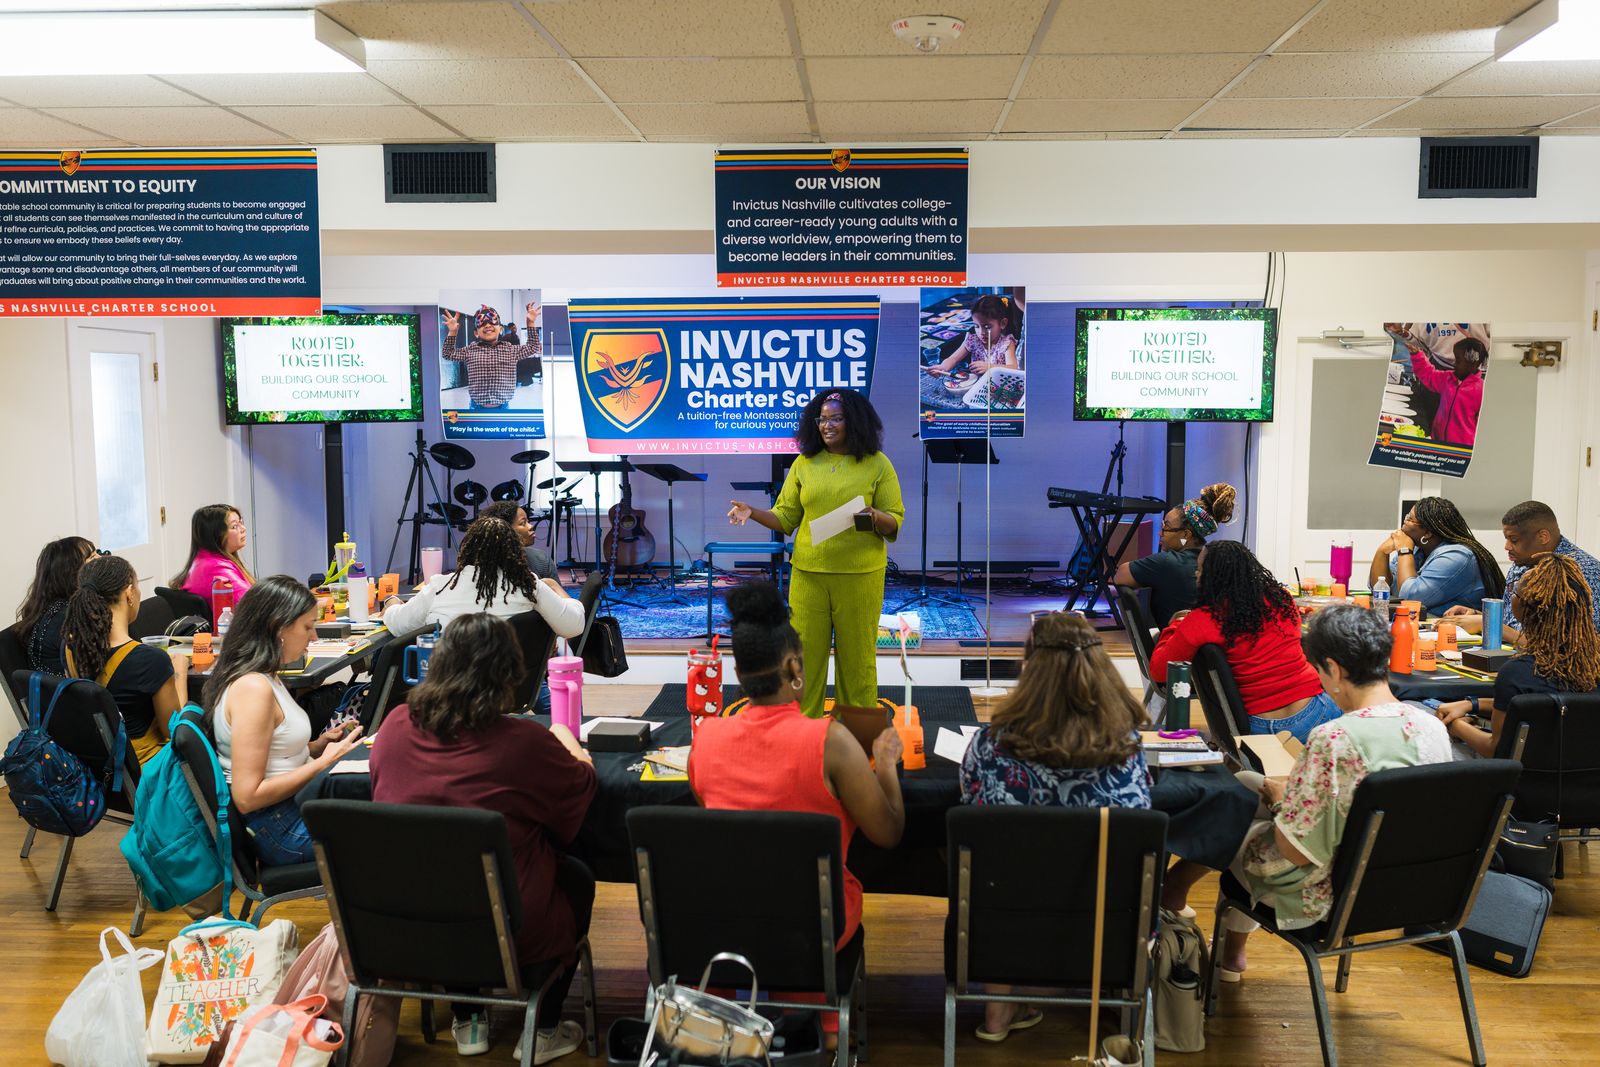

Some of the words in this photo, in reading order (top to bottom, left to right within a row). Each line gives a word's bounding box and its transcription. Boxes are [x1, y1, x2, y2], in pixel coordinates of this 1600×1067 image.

[112, 180, 136, 193] TO
[139, 180, 197, 194] EQUITY
[796, 177, 827, 189] OUR
[830, 177, 881, 189] VISION
[49, 202, 95, 211] community
[146, 201, 185, 211] preparing
[268, 201, 306, 210] engaged
[732, 200, 778, 210] Invictus
[782, 200, 836, 210] Nashville
[839, 199, 898, 209] cultivates
[901, 198, 952, 211] college-
[84, 213, 129, 221] themselves
[131, 213, 176, 221] manifested
[201, 212, 245, 220] curriculum
[727, 217, 750, 227] and
[754, 217, 835, 230] career-ready
[838, 218, 877, 229] young
[880, 216, 918, 226] adults
[921, 215, 946, 226] with
[28, 225, 65, 234] curricula,
[67, 225, 99, 234] policies,
[117, 224, 157, 234] practices.
[215, 224, 244, 233] having
[260, 223, 310, 233] appropriate
[56, 236, 90, 245] embody
[165, 235, 183, 244] day.
[722, 234, 766, 245] diverse
[769, 233, 832, 246] worldview,
[834, 233, 912, 246] empowering
[915, 233, 947, 243] them
[950, 233, 962, 243] to
[59, 253, 105, 263] community
[116, 253, 138, 262] bring
[201, 253, 242, 262] everyday.
[268, 253, 298, 262] explore
[729, 251, 778, 262] become
[782, 251, 827, 261] leaders
[830, 251, 840, 261] in
[844, 250, 871, 261] their
[874, 250, 956, 260] communities.
[73, 265, 129, 274] disadvantage
[130, 265, 158, 274] others,
[237, 264, 284, 274] community
[52, 276, 73, 286] bring
[100, 276, 132, 286] positive
[133, 276, 164, 285] change
[11, 304, 86, 312] NASHVILLE
[92, 304, 154, 312] CHARTER
[160, 304, 216, 312] SCHOOL
[292, 337, 354, 350] ROOTED
[680, 329, 866, 360] INVICTUS
[1144, 332, 1207, 346] ROOTED
[278, 354, 364, 367] TOGETHER:
[1129, 350, 1215, 364] TOGETHER:
[262, 375, 313, 384] BUILDING
[316, 375, 338, 383] OUR
[342, 374, 388, 383] SCHOOL
[680, 362, 867, 388] NASHVILLE
[1111, 372, 1161, 380] BUILDING
[1165, 372, 1188, 381] OUR
[1192, 372, 1238, 381] SCHOOL
[292, 390, 360, 399] COMMUNITY
[1140, 387, 1208, 396] COMMUNITY
[687, 390, 778, 409] Charter
[687, 411, 741, 420] tuition-free
[744, 411, 797, 420] Montessori
[715, 420, 728, 429] for
[730, 420, 766, 429] curious
[769, 422, 799, 431] young
[637, 441, 803, 450] WWW.INVICTUS-NASH.O
[165, 977, 262, 1002] TEACHER
